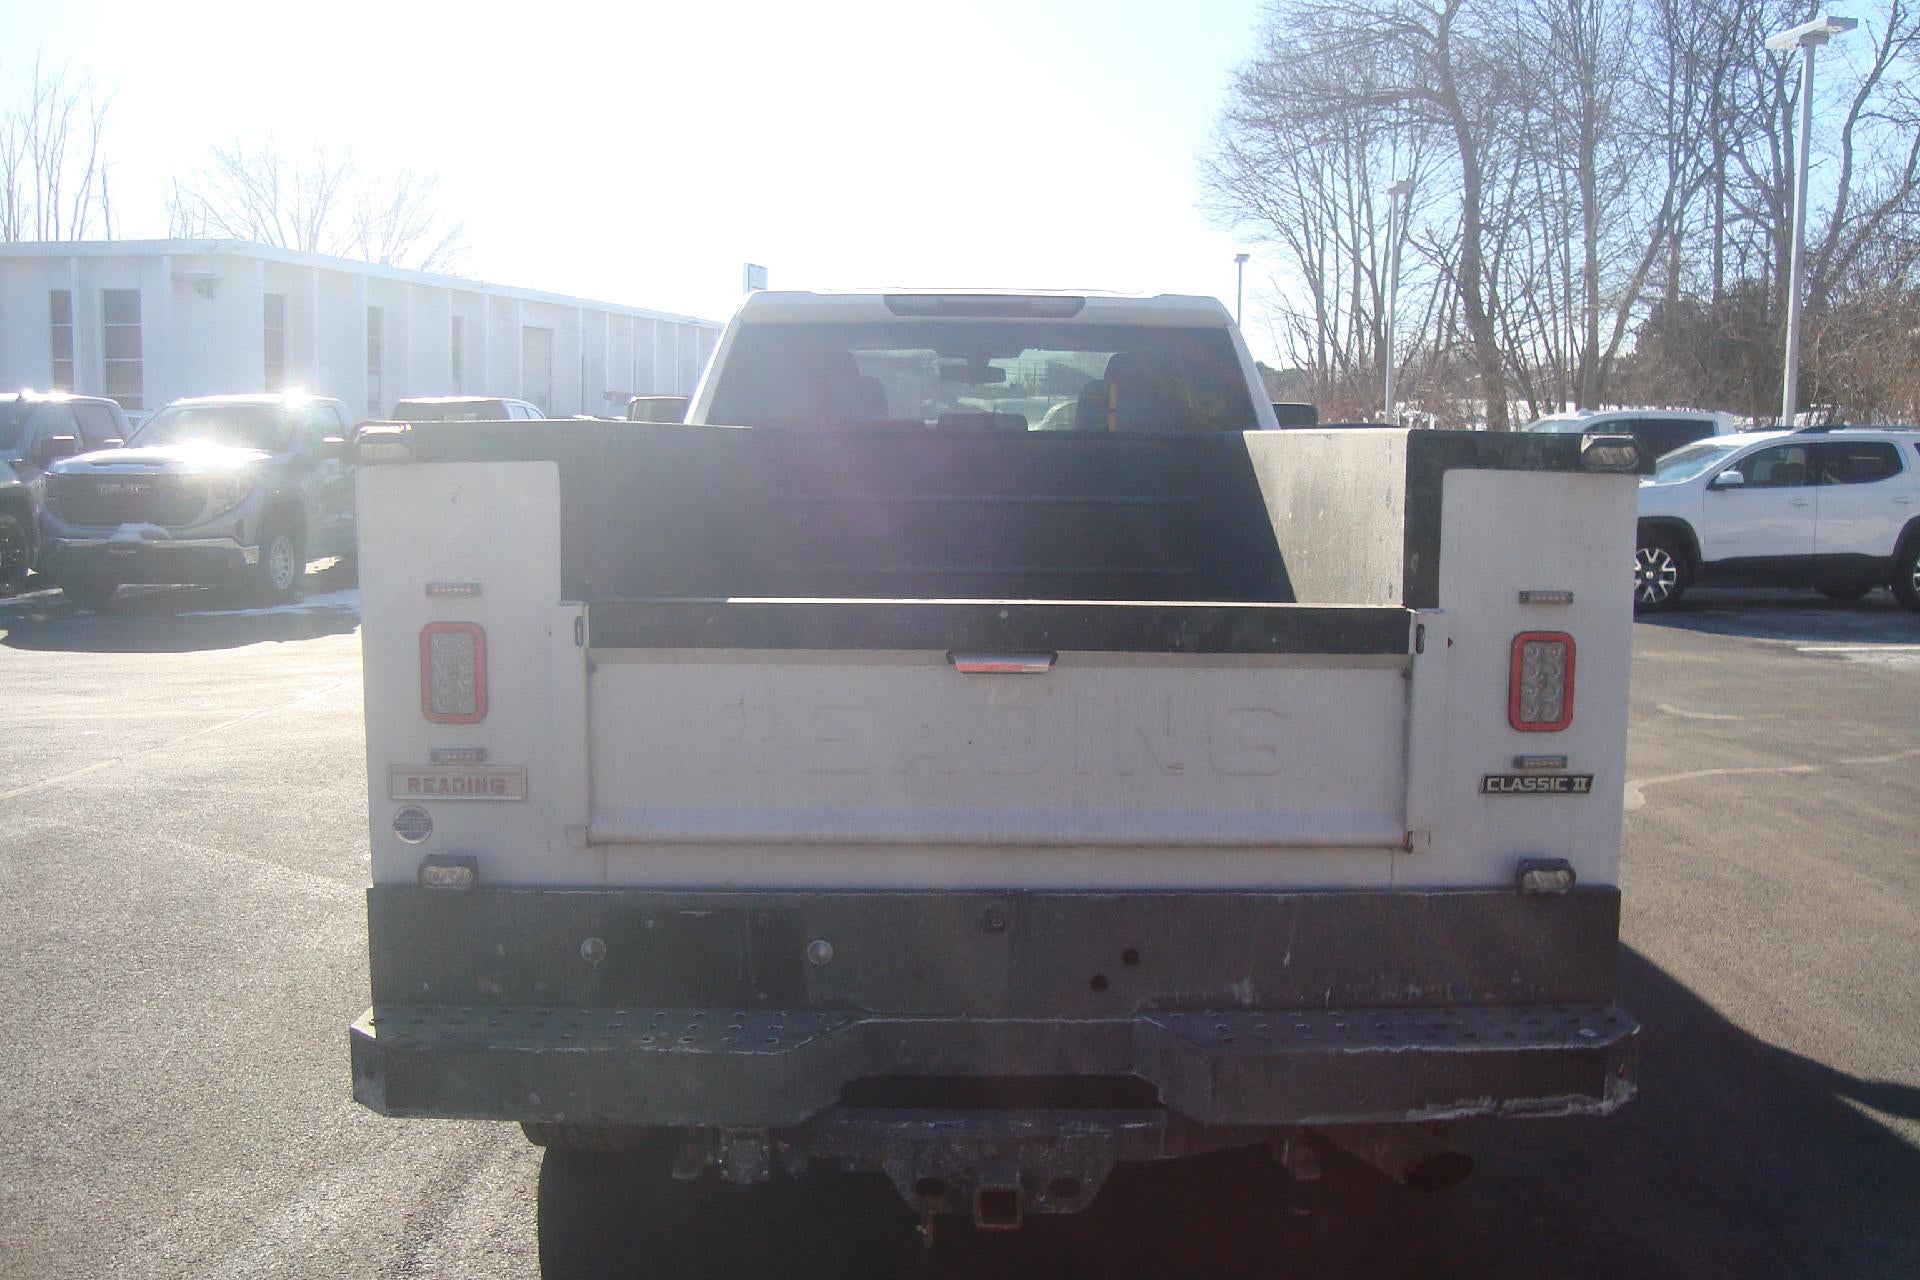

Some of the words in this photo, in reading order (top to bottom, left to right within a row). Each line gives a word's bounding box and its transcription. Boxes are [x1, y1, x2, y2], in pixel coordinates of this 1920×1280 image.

[407, 777, 507, 794] READING
[1486, 777, 1569, 792] CLASSIC
[1572, 777, 1588, 792] II
